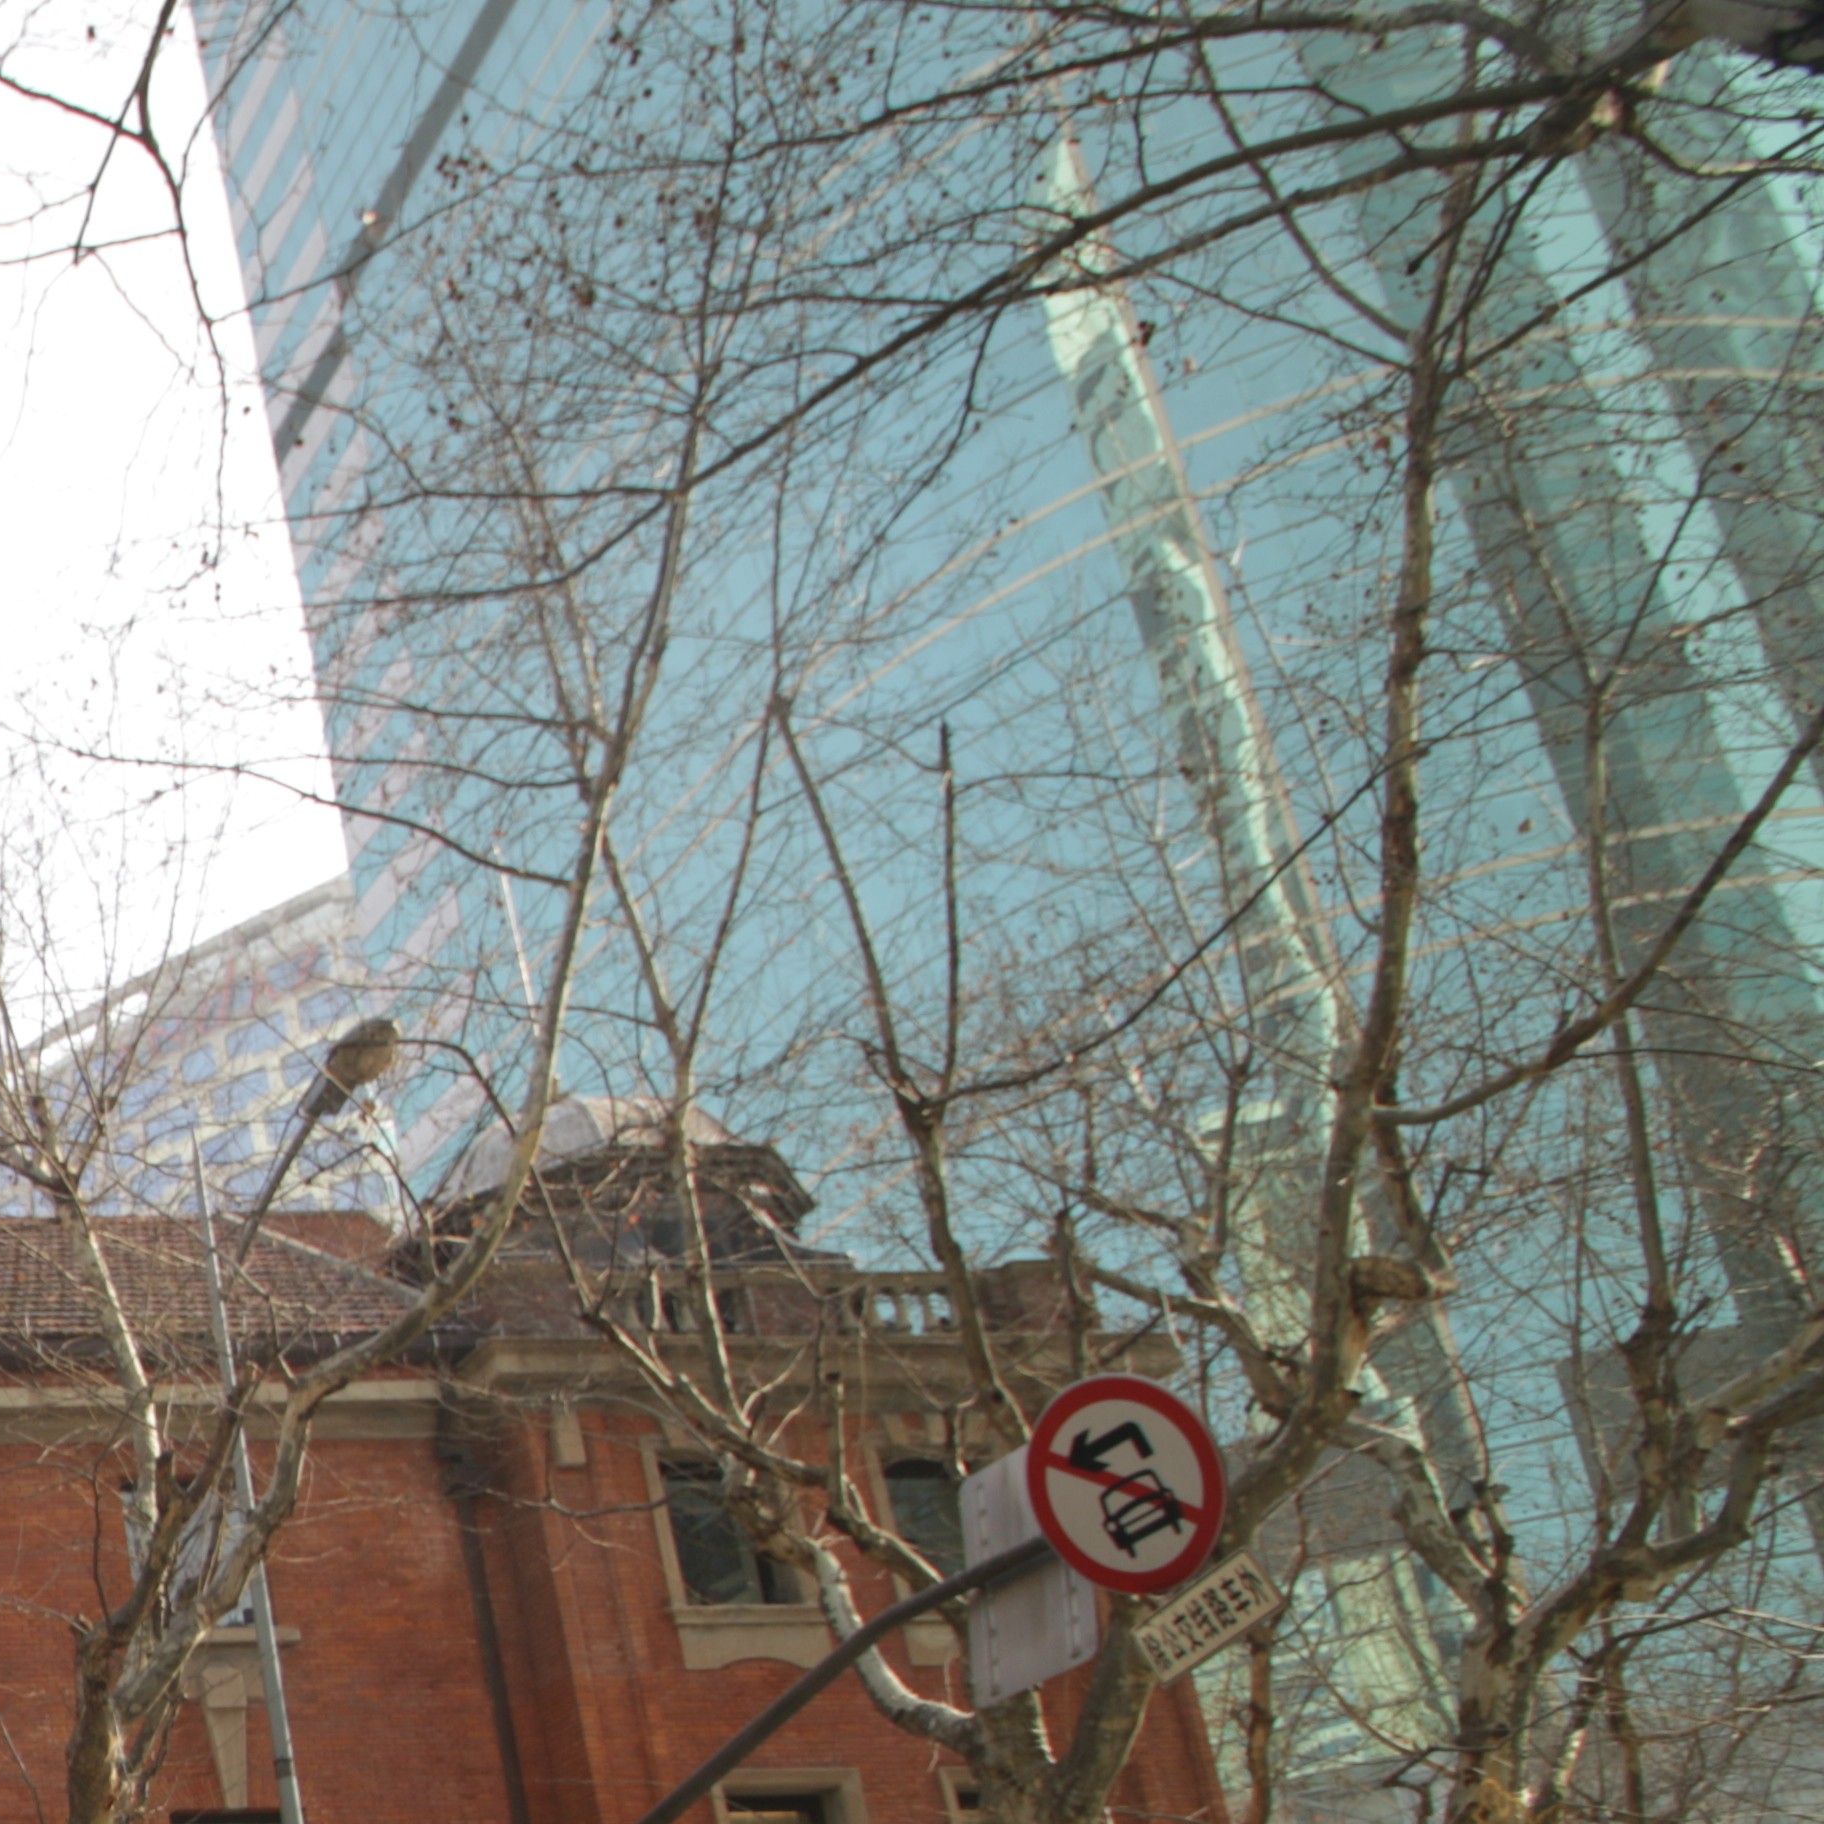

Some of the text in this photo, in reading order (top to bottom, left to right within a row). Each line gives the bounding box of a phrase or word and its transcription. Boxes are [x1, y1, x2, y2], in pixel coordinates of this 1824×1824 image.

[1142, 1564, 1269, 1670] 除公交线路车外
